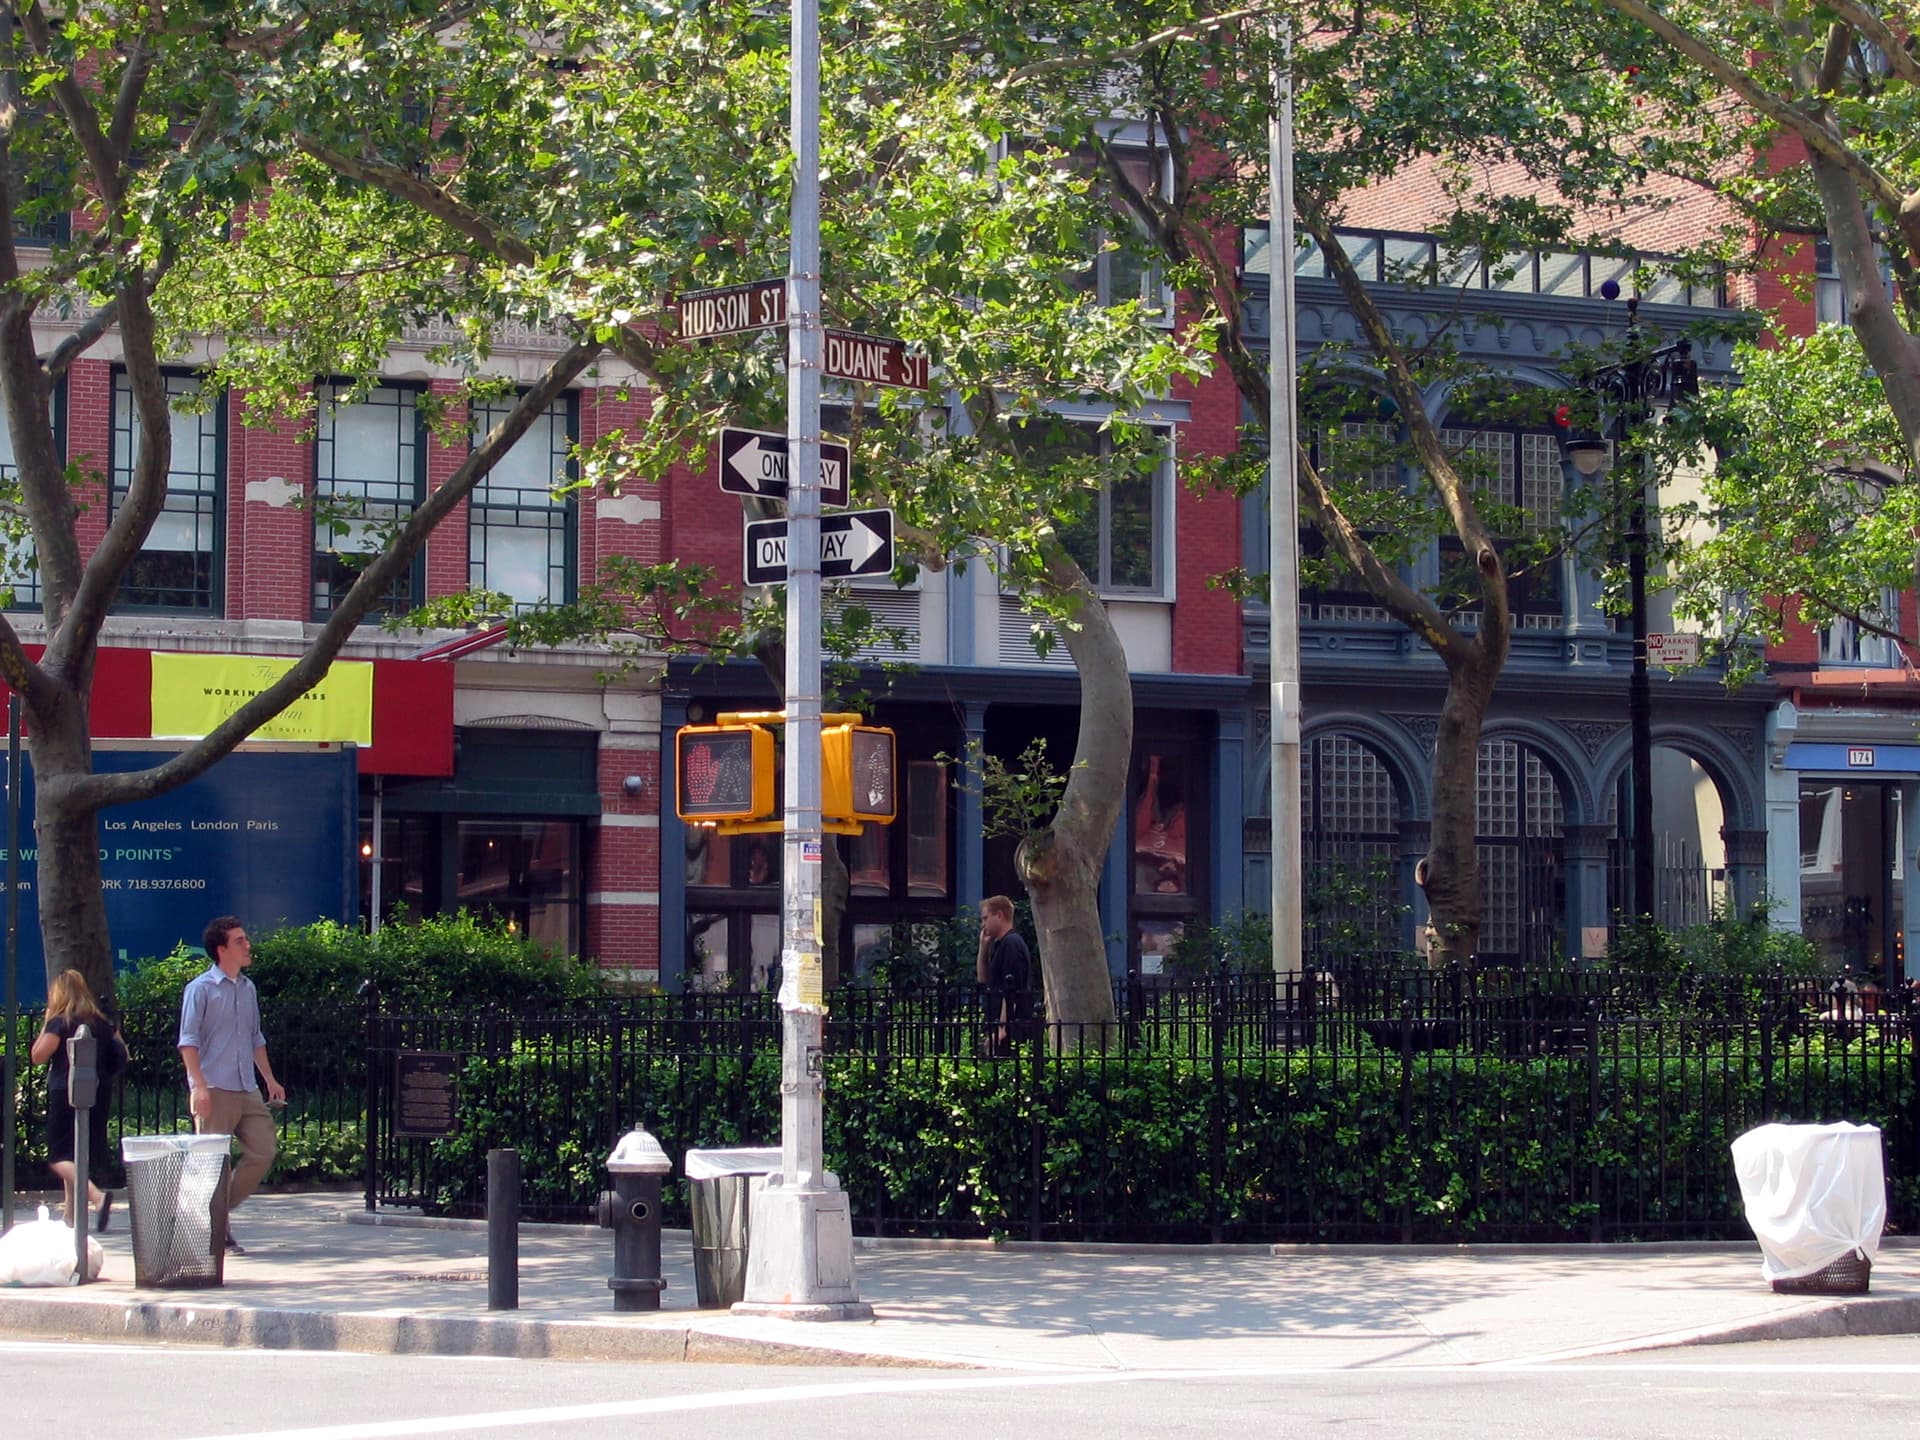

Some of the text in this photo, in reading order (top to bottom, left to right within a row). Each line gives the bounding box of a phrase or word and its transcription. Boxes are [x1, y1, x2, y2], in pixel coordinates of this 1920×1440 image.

[682, 287, 781, 337] HUDSON ST
[828, 338, 891, 381] DUANE
[900, 351, 925, 387] ST
[762, 534, 848, 565] ON AY
[1648, 635, 1695, 647] NO PARKING
[1656, 648, 1689, 656] ANYTIME
[1853, 751, 1870, 763] 174
[104, 819, 279, 833] Los Angeles London Paris
[128, 879, 206, 890] 718.937.6800
